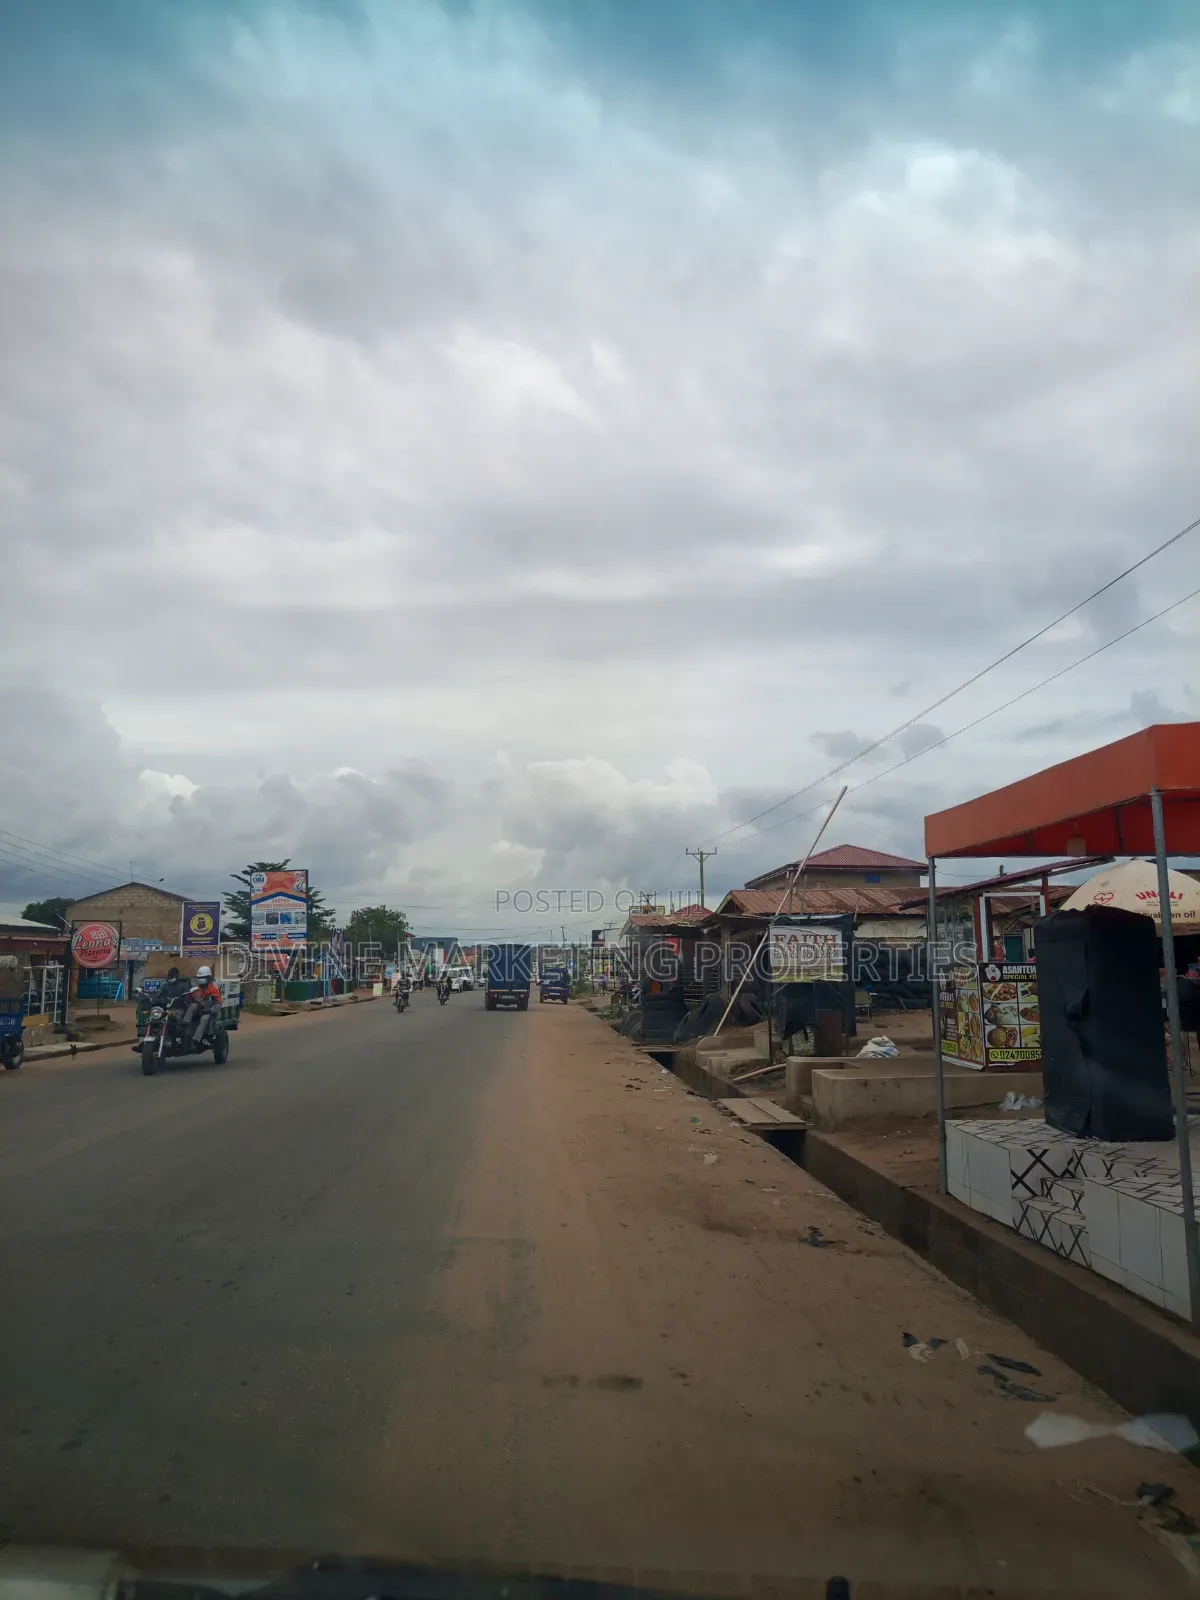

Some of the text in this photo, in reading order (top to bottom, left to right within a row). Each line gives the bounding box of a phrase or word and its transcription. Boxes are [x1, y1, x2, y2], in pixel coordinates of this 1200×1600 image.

[1135, 890, 1184, 900] UNLI
[773, 934, 839, 945] FAITH
[80, 947, 111, 957] Pizzeria
